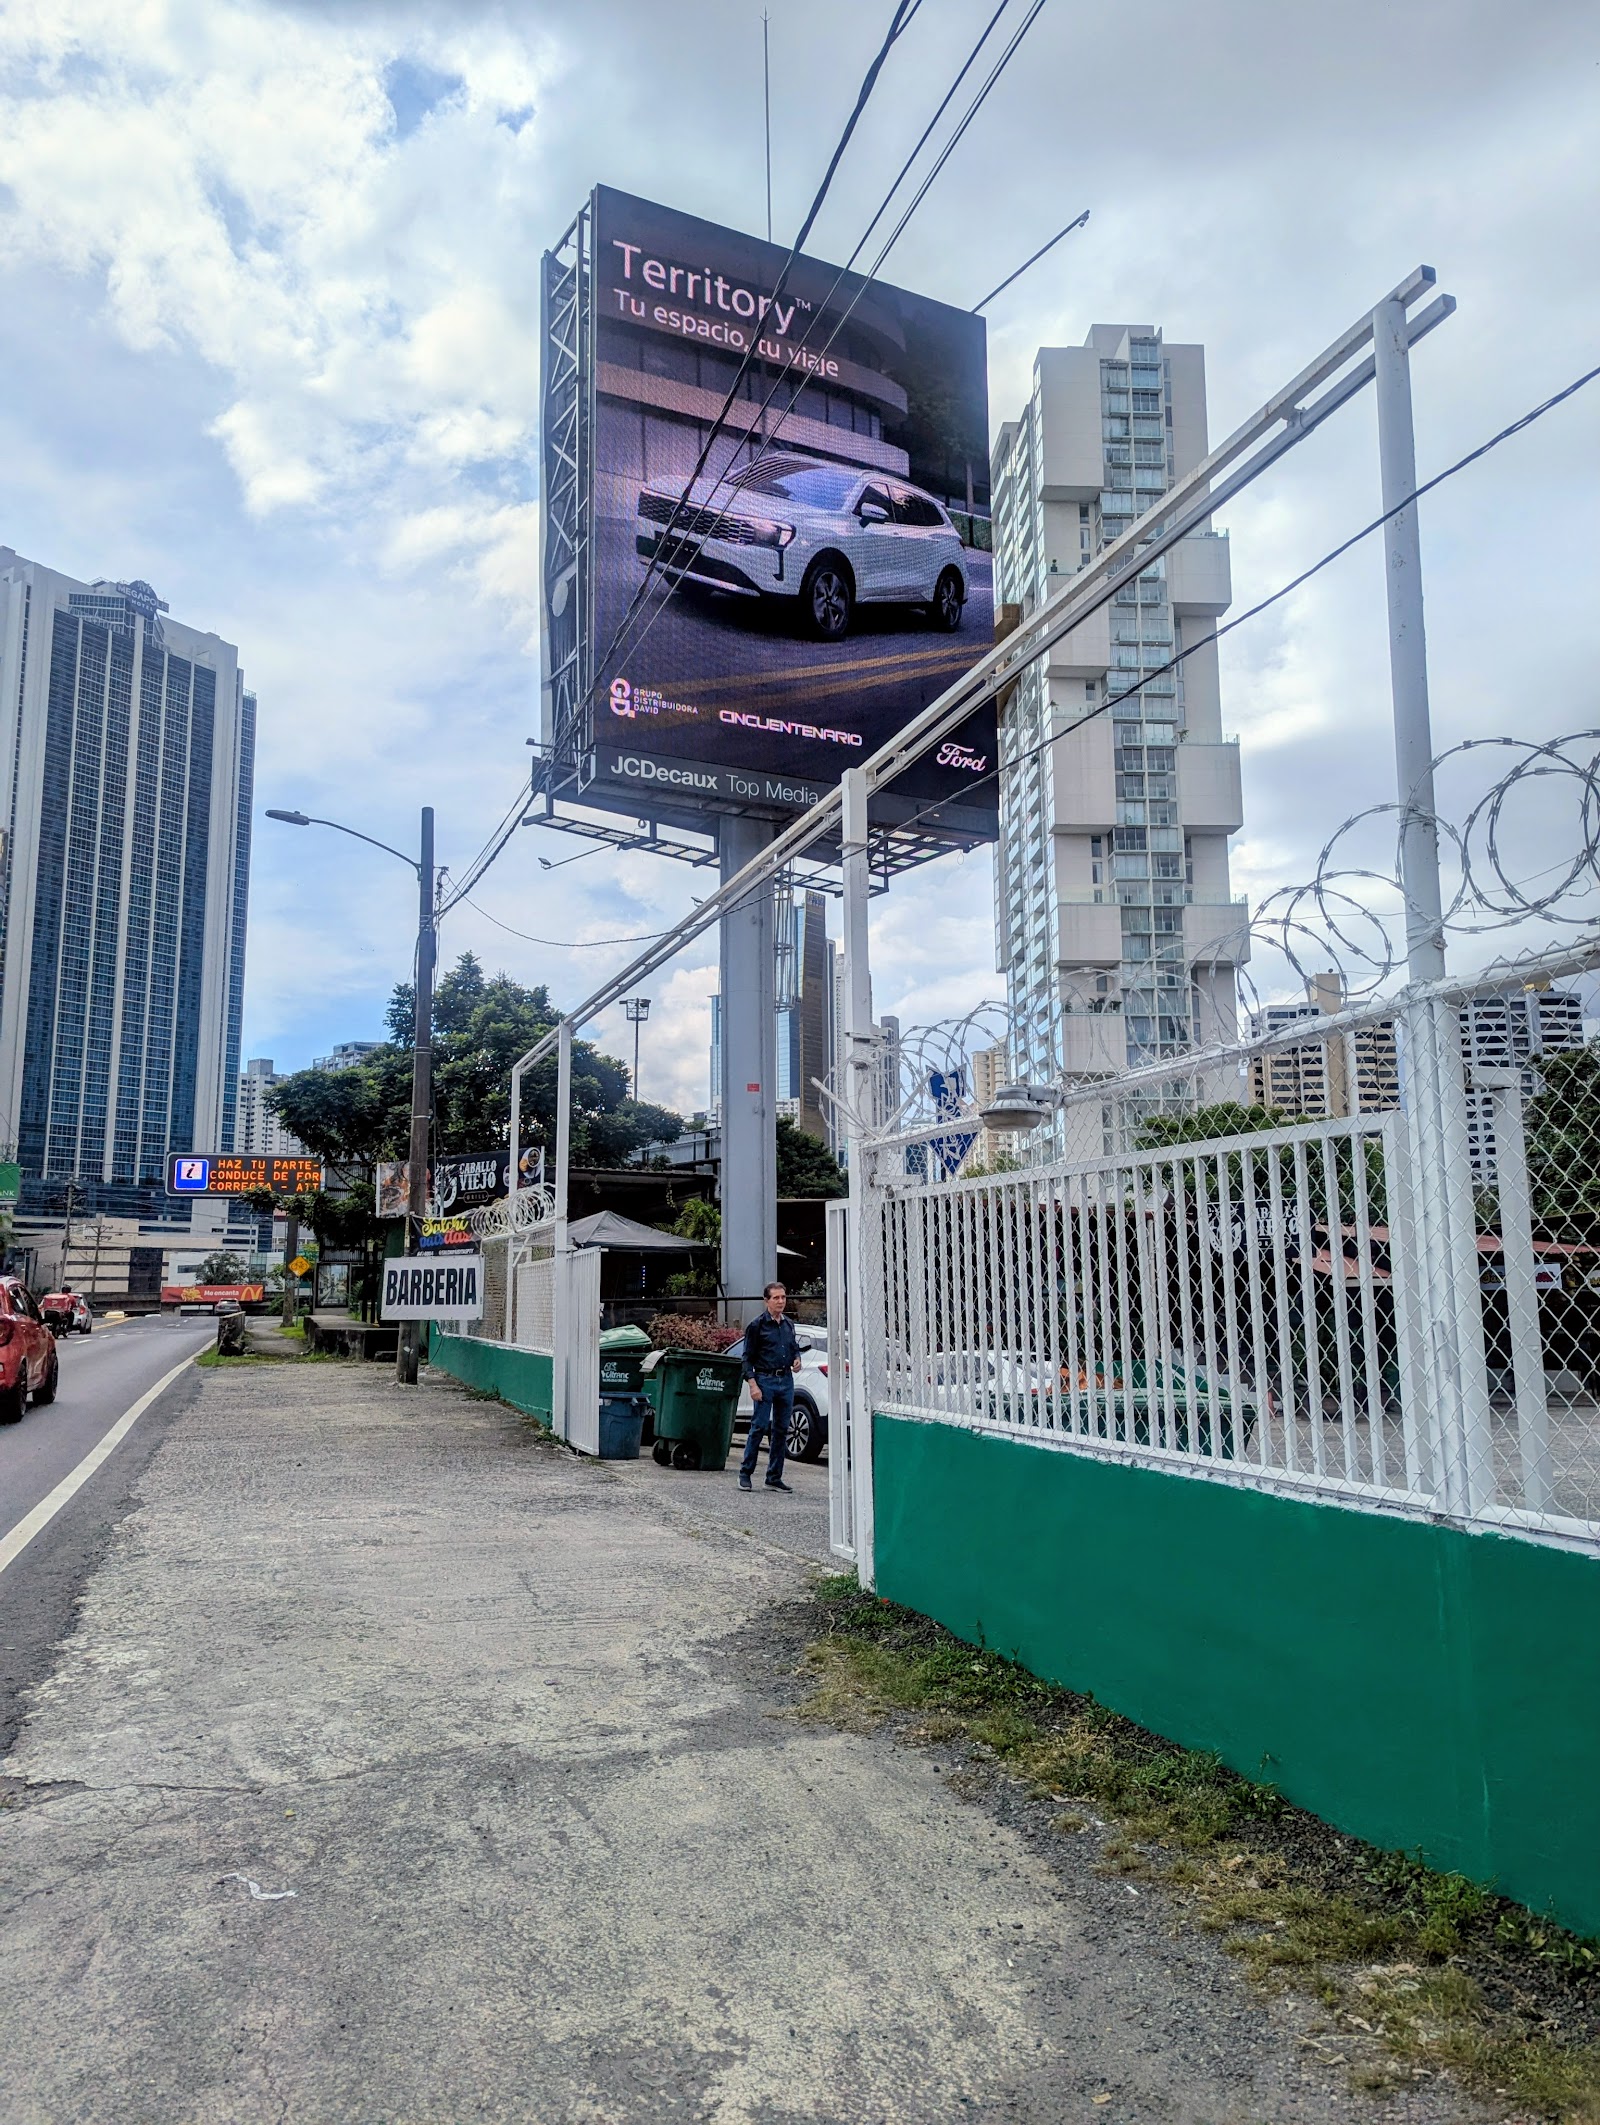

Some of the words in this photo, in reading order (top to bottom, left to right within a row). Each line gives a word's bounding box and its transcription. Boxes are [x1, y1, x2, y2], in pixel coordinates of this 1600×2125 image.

[613, 288, 646, 318] Tu
[757, 338, 781, 358] tu
[788, 345, 839, 377] viaje
[117, 584, 169, 610] MEGAPOLIS
[131, 599, 154, 612] HOTEL
[633, 687, 663, 700] GRUPO
[633, 695, 699, 715] DISTRIBUIDORA
[633, 703, 660, 715] DAVID
[719, 709, 863, 747] CINCUENTENARIO
[936, 742, 987, 772] Ford
[610, 755, 719, 791] JCDecaux
[726, 773, 760, 799] Top
[765, 779, 819, 806] Media
[218, 1159, 242, 1169] HAZ
[251, 1159, 266, 1170] TU
[458, 1159, 498, 1175] CABALLO
[209, 1170, 265, 1181] CONDUCE
[273, 1171, 289, 1181] DE
[296, 1171, 322, 1182] FOR
[458, 1171, 497, 1191] VIEJO
[203, 1289, 213, 1297] Me
[385, 1267, 477, 1306] BARBERIA
